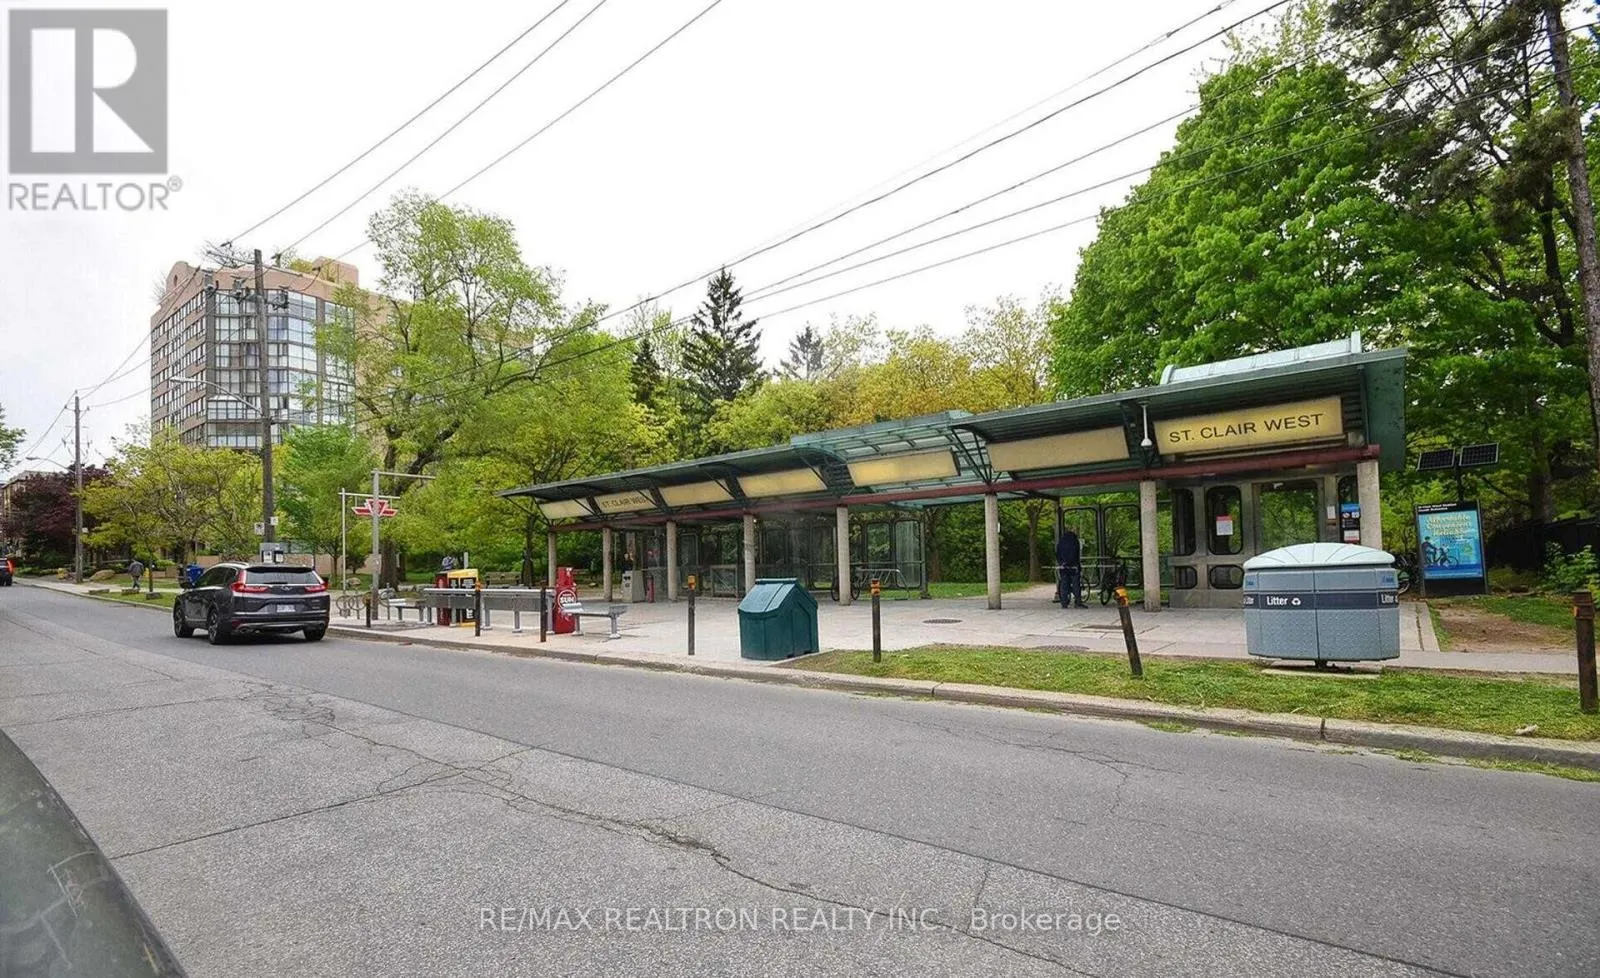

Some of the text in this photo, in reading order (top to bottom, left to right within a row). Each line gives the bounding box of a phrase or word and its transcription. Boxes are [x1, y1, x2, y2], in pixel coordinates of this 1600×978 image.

[1169, 413, 1323, 443] ST. CLAIR WEST
[1266, 595, 1288, 605] Litter
